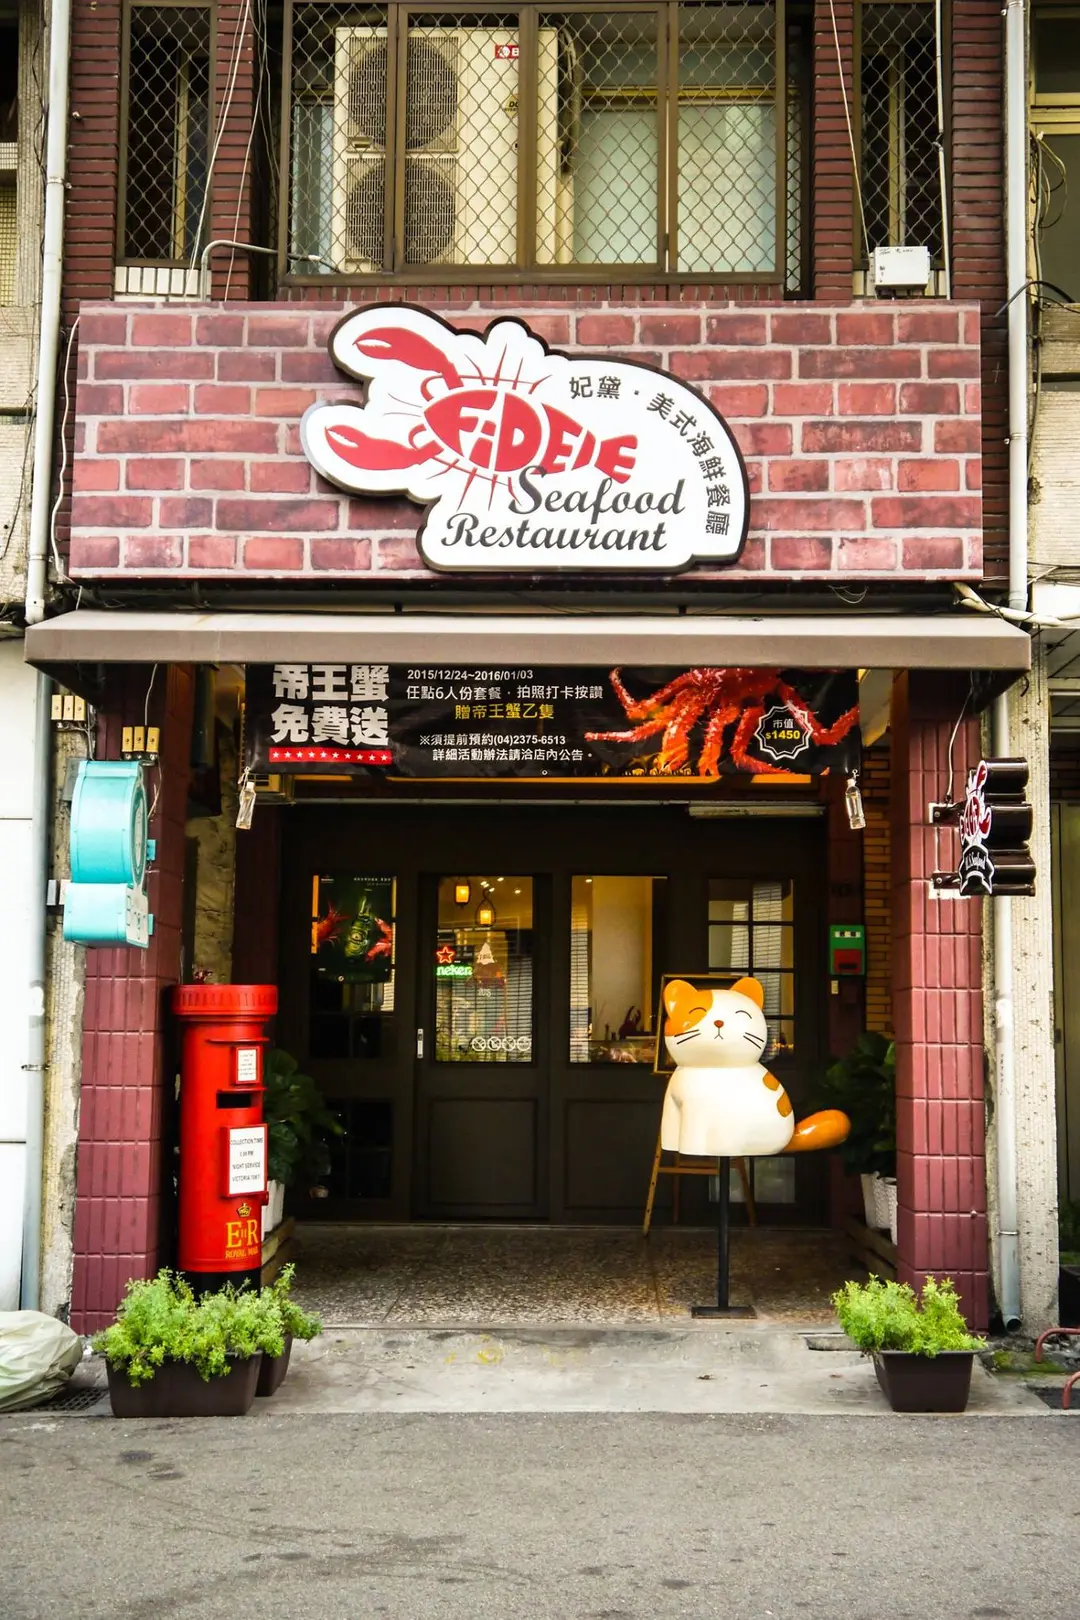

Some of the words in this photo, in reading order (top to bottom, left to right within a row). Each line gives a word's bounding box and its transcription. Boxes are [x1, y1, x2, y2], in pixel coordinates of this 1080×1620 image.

[508, 465, 686, 525] Seafood
[441, 512, 667, 552] Restaurant
[272, 664, 390, 702] 帝王蟹
[407, 669, 534, 681] 2015/12/24~2016/01/03
[270, 703, 389, 746] 免費送
[455, 702, 555, 720] 贈帝王蟹乙隻
[772, 718, 794, 729] 市值
